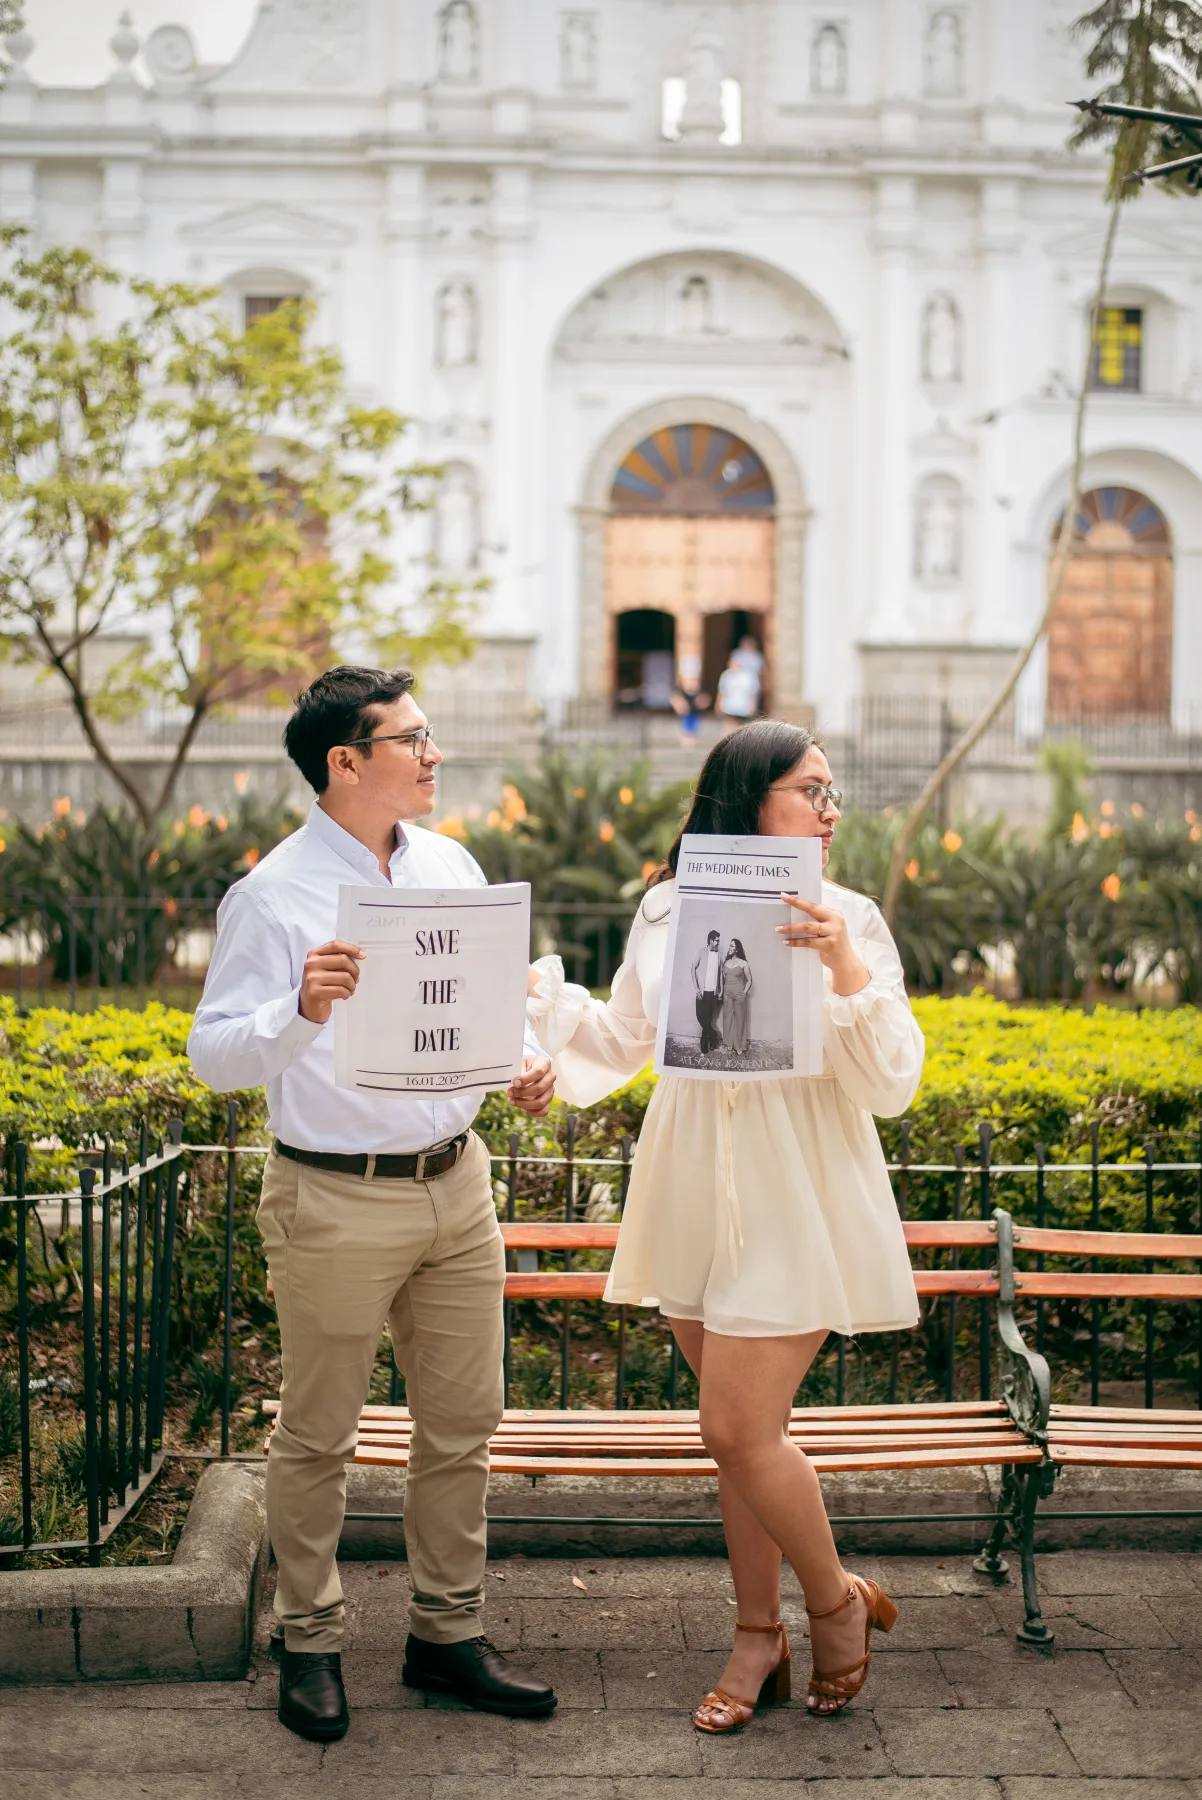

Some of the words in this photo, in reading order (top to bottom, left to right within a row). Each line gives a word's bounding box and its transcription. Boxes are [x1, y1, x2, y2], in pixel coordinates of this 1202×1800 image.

[687, 862, 704, 873] THE
[705, 863, 752, 876] WEDDING
[754, 865, 790, 878] TIMES
[415, 929, 460, 956] SAVE
[418, 979, 458, 1005] THE
[413, 1027, 461, 1053] DATE
[405, 1074, 466, 1086] 16.01.2027
